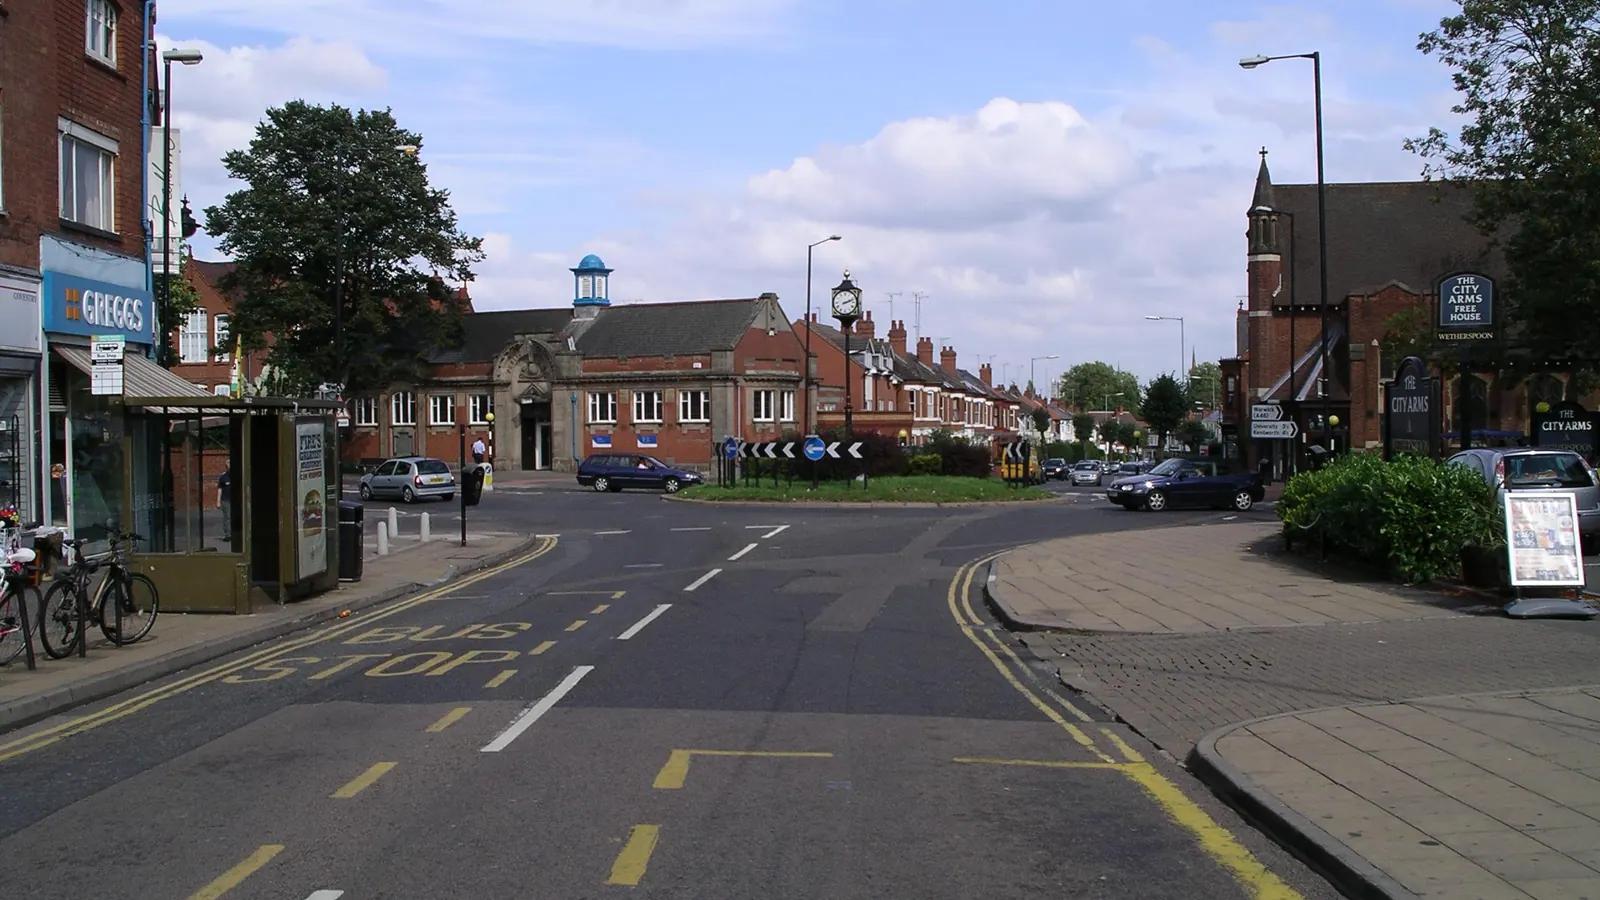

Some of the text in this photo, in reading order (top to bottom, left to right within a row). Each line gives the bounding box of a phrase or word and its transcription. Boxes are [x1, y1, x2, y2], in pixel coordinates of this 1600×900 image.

[1457, 277, 1476, 285] THE
[1452, 285, 1480, 294] CITY
[1448, 294, 1483, 304] ARMS
[82, 290, 143, 332] GREGGS
[1454, 305, 1477, 313] FREE
[1450, 313, 1482, 321] HOUSE
[1438, 332, 1493, 340] WETHERSPOON
[1404, 375, 1416, 390] THE
[1391, 396, 1429, 413] CITY ARMS
[1559, 409, 1575, 419] THE
[1542, 421, 1592, 431] CITY ARMS
[340, 622, 532, 645] BUS
[222, 650, 520, 684] STOP
